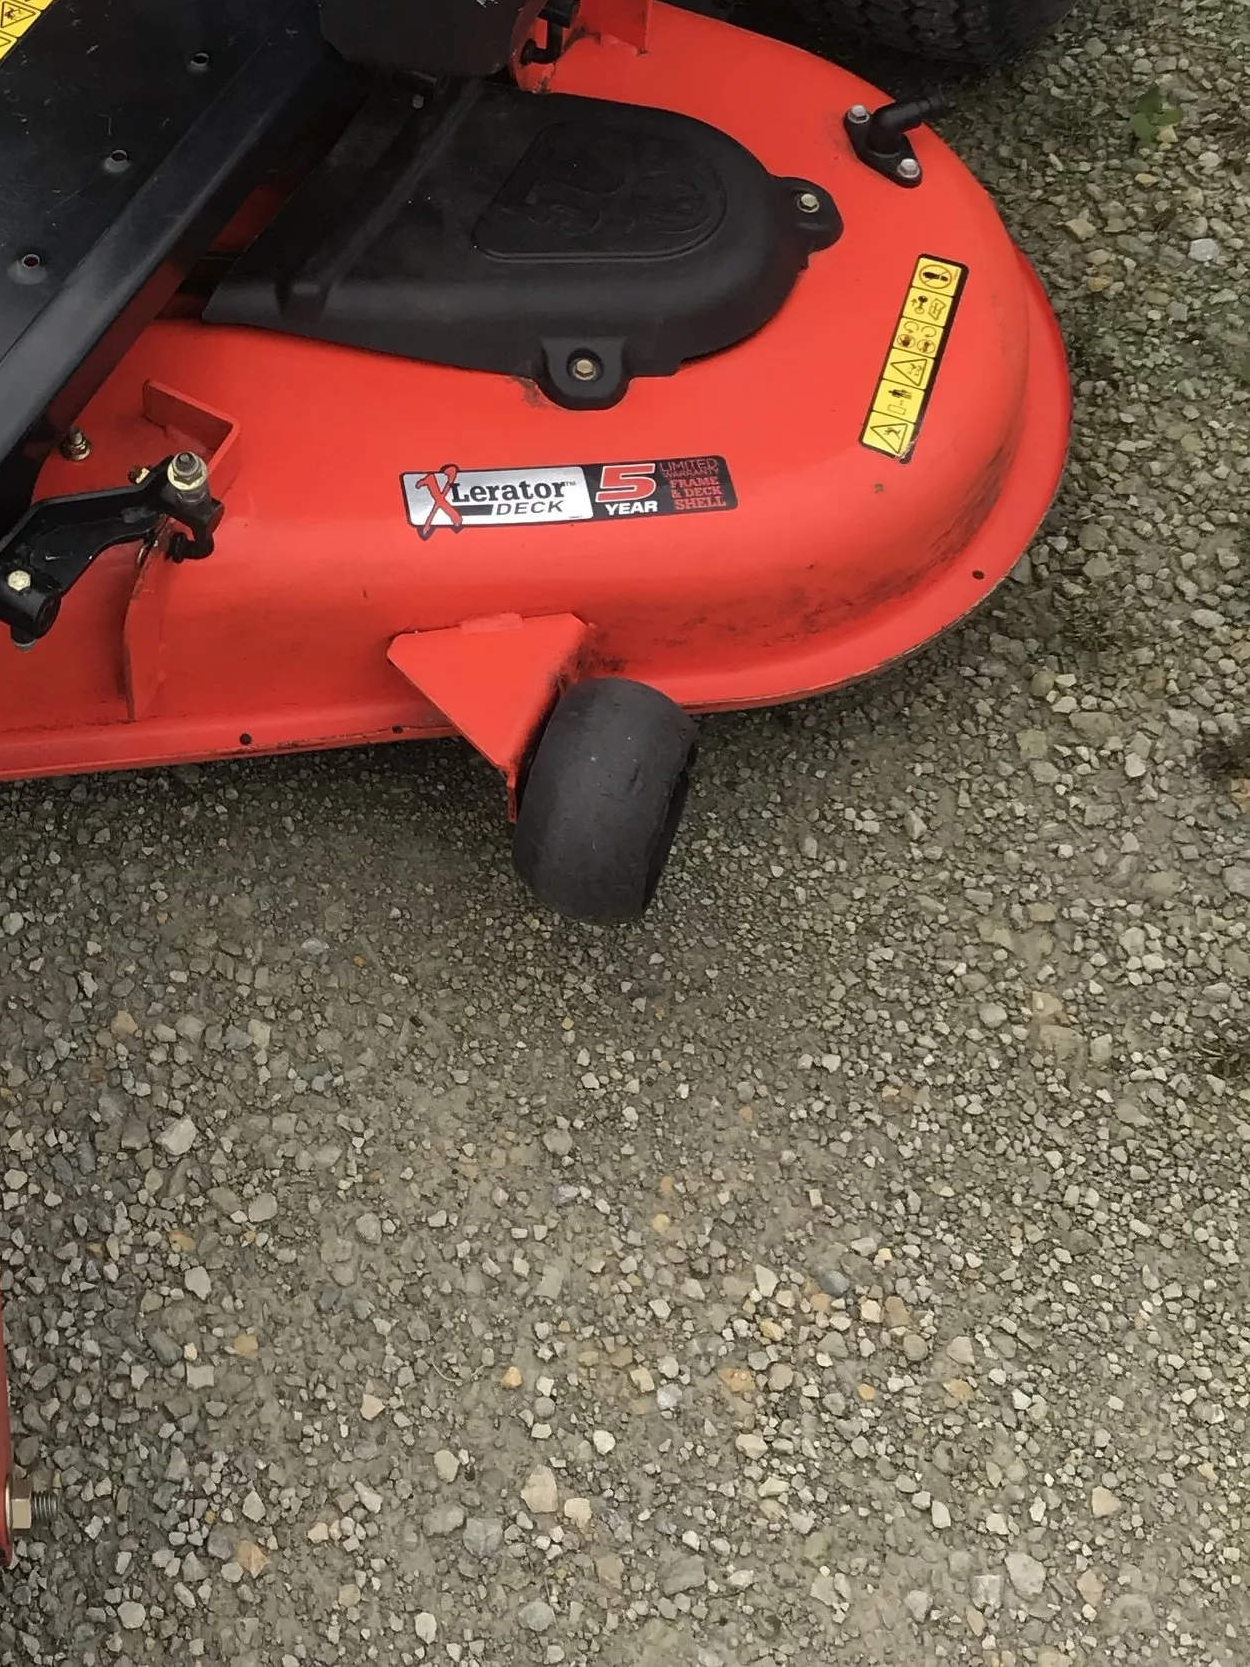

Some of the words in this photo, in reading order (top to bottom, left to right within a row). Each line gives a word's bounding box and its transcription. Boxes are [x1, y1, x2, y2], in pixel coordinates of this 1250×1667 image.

[659, 458, 718, 472] LIMITED
[662, 467, 719, 478] WARRANTY
[595, 463, 657, 503] 5
[670, 476, 719, 488] FRAME
[671, 488, 681, 499] &
[684, 485, 723, 497] DECK
[496, 500, 564, 516] DECK
[605, 500, 658, 516] YEAR
[675, 496, 727, 510] SHELL
